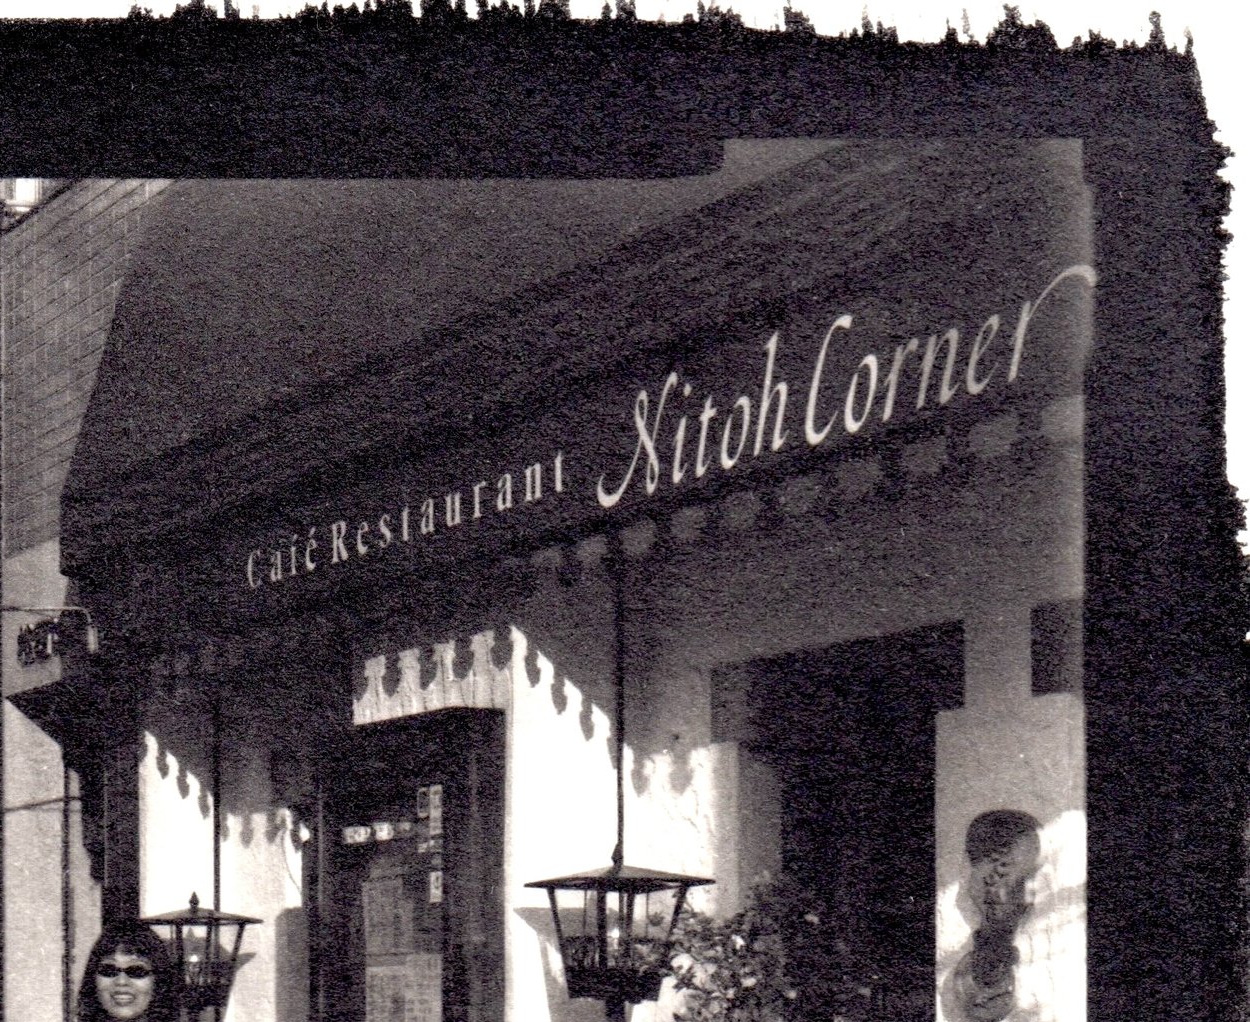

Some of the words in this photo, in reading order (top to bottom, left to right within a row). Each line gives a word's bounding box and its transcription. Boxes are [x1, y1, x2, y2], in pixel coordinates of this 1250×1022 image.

[246, 526, 318, 588] Café
[330, 450, 566, 563] Restaurant
[595, 330, 788, 508] Nitoh
[805, 263, 1098, 446] Corner
